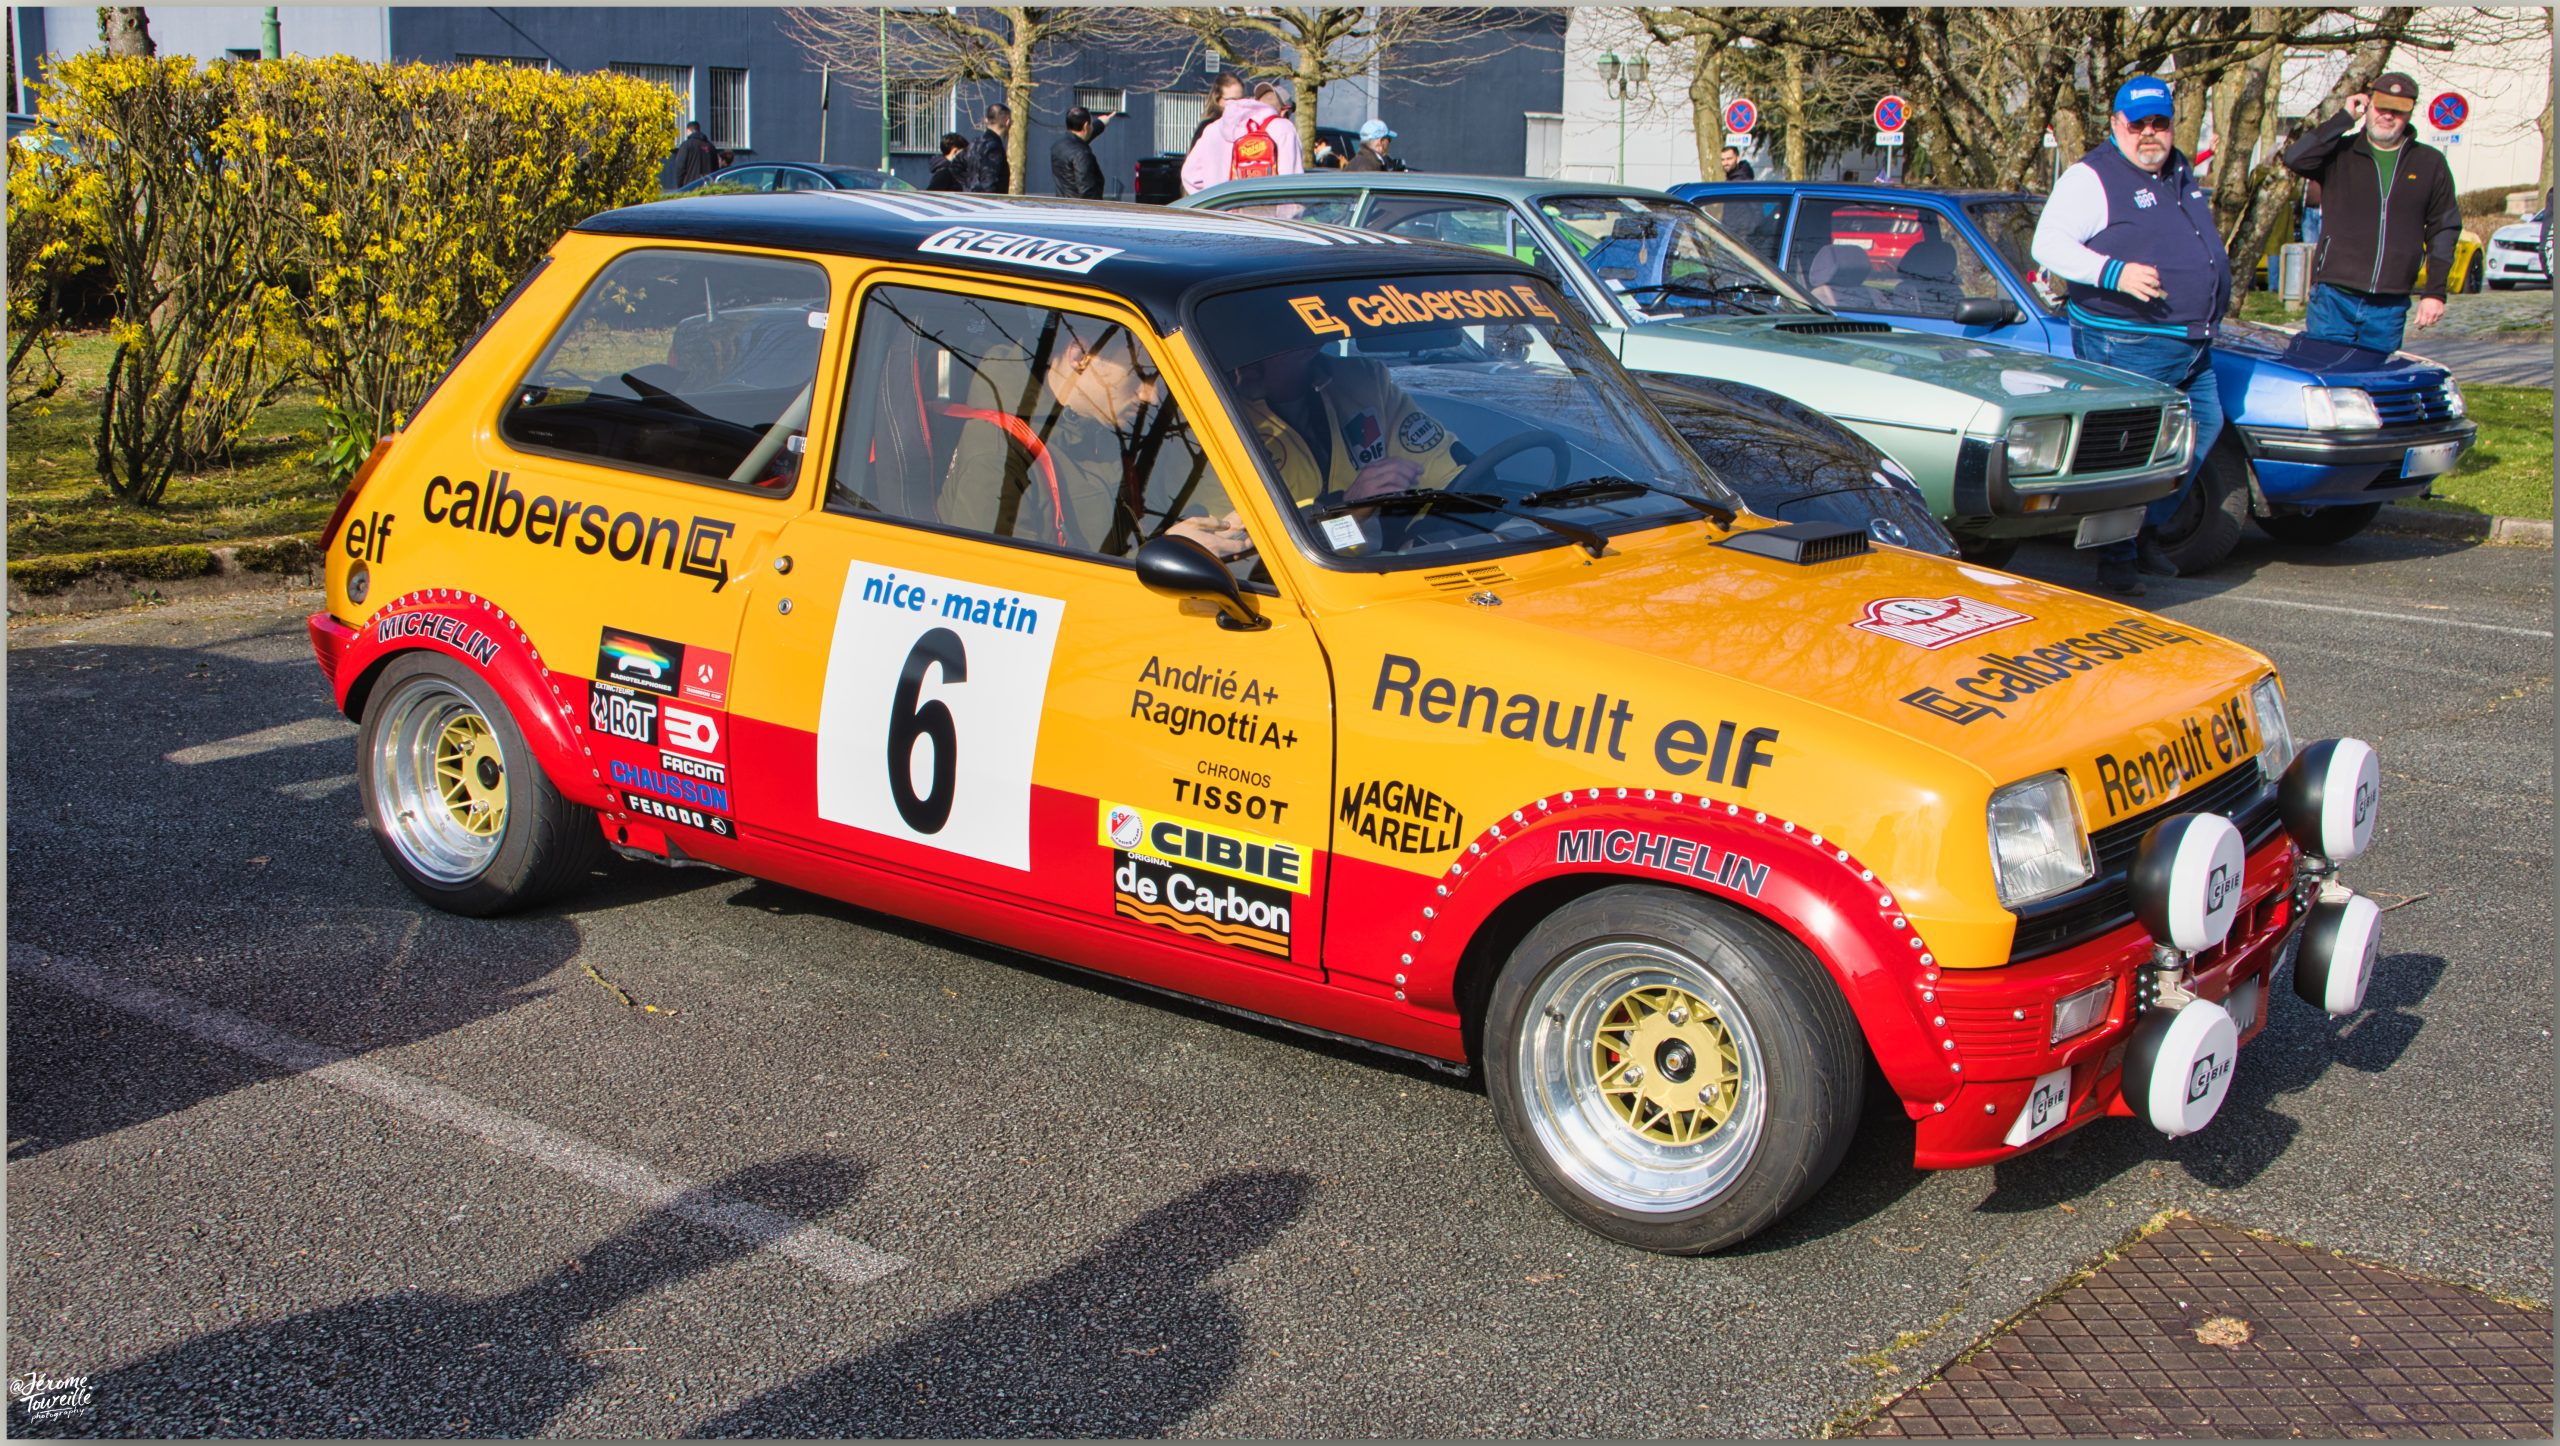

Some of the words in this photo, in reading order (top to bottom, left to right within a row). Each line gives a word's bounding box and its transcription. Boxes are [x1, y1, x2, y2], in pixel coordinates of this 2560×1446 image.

[2134, 192, 2157, 208] 1889
[934, 229, 1103, 266] REIMS
[1347, 285, 1526, 328] calberson
[1360, 441, 1384, 463] elf
[346, 511, 395, 564] elf
[423, 470, 680, 570] calberson
[1895, 604, 1933, 616] 6
[378, 611, 501, 668] MICHELIN
[610, 672, 672, 692] RADIOTELEPHONES
[1138, 655, 1238, 701] Andrié
[1240, 678, 1279, 707] A+
[1955, 622, 2159, 704] calberson
[595, 681, 635, 696] EXTINCTEURS
[887, 627, 967, 835] 6
[1130, 689, 1259, 743] Ragnotti
[1259, 722, 1298, 750] A+
[1371, 653, 1634, 762] Renault
[1654, 719, 1780, 789] elf
[662, 754, 725, 784] FACOM
[1197, 760, 1271, 788] CHRONOS
[2096, 720, 2213, 817] Renault
[2212, 696, 2249, 766] elf
[610, 759, 728, 812] CHAUSSON
[1172, 778, 1288, 824] TISSOT
[1340, 780, 1463, 835] MAGNETI
[628, 795, 705, 828] FERODO
[1340, 807, 1462, 854] MARELLI
[1127, 851, 1172, 868] ORIGINAL
[1150, 821, 1300, 886] CIBIÉ
[1556, 829, 1770, 898] MICHELIN
[1115, 861, 1158, 904] de
[1166, 872, 1290, 932] Carbon
[2213, 872, 2241, 899] CIBIE
[2197, 1059, 2231, 1087] CIBIE
[2037, 1089, 2065, 1114] CIBIE
